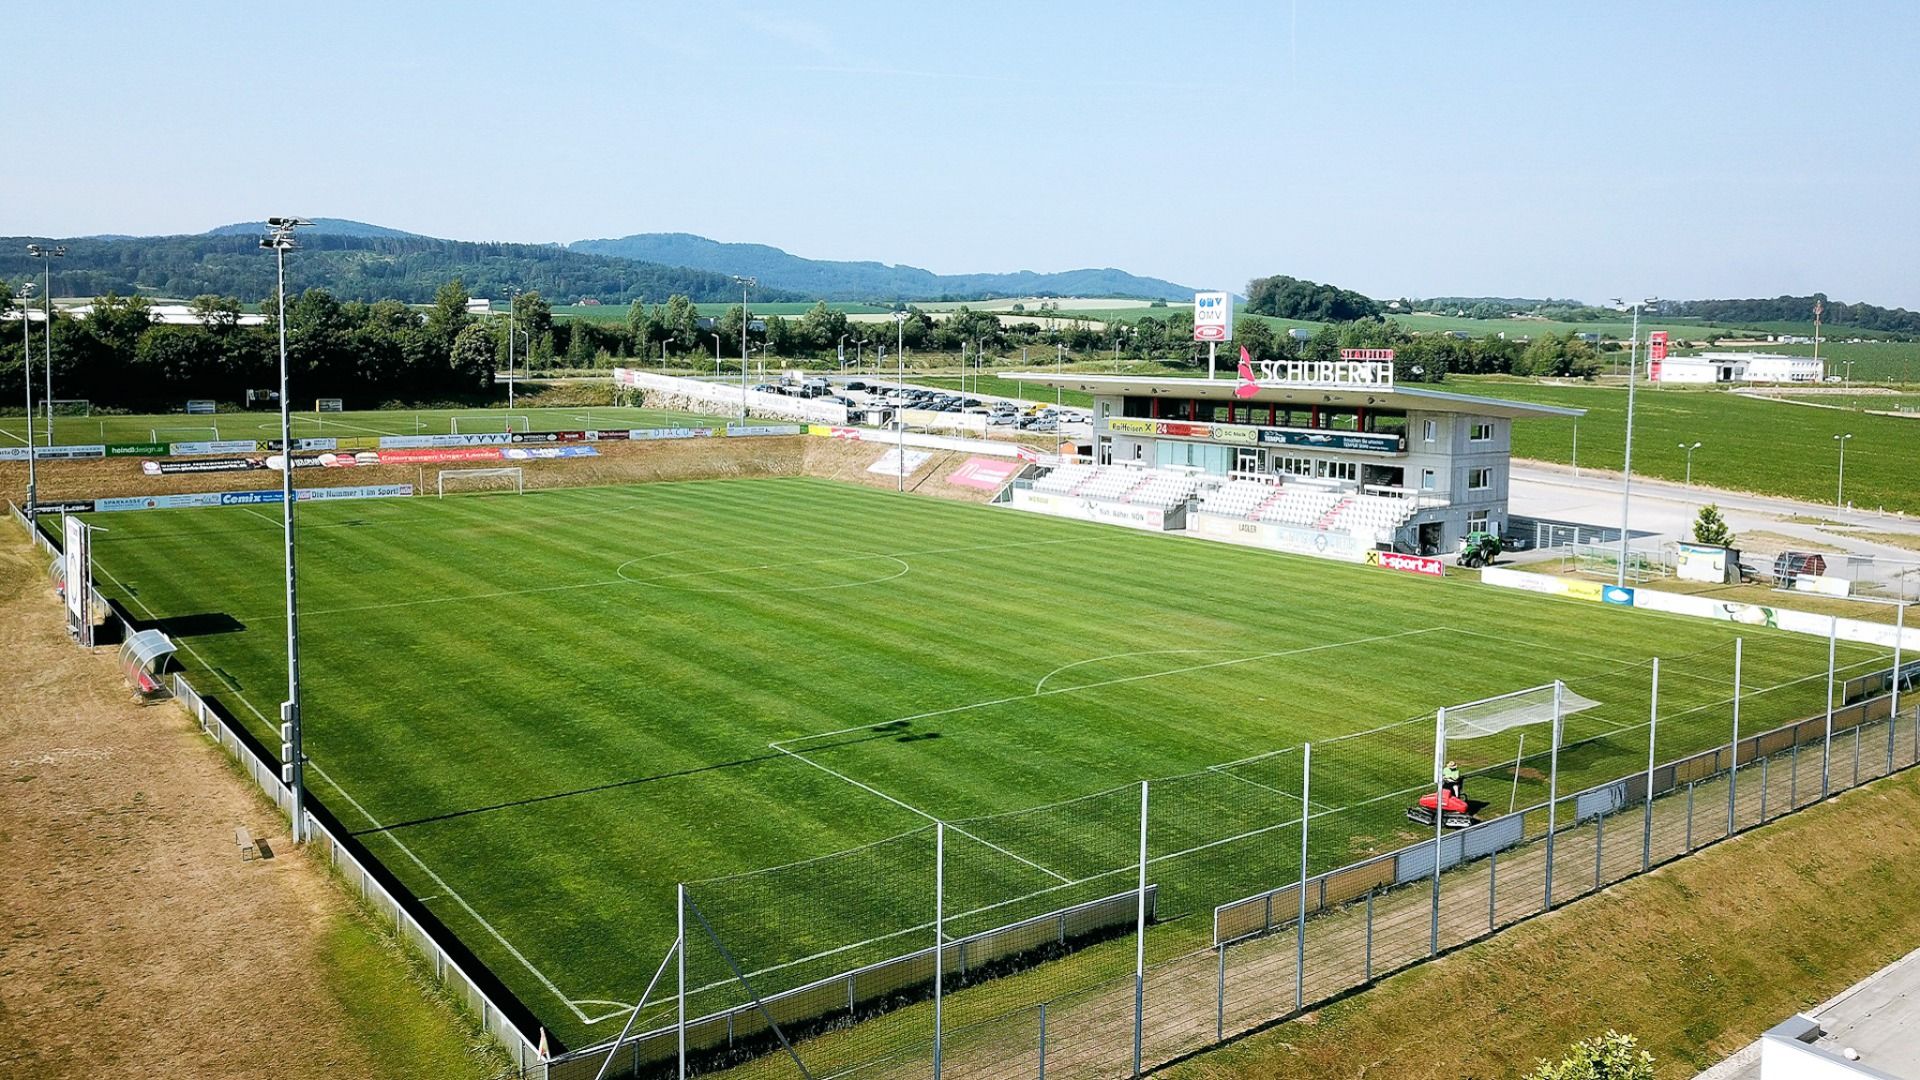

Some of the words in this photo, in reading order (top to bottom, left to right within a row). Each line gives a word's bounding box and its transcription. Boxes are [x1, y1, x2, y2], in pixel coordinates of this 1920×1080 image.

[1198, 310, 1222, 320] OMV
[1260, 360, 1393, 386] SCHUBERTH
[1112, 422, 1144, 432] Raiffeisen
[1156, 423, 1168, 434] 24
[223, 493, 262, 504] Comix
[312, 490, 324, 498] Die
[326, 489, 357, 497] Nummer
